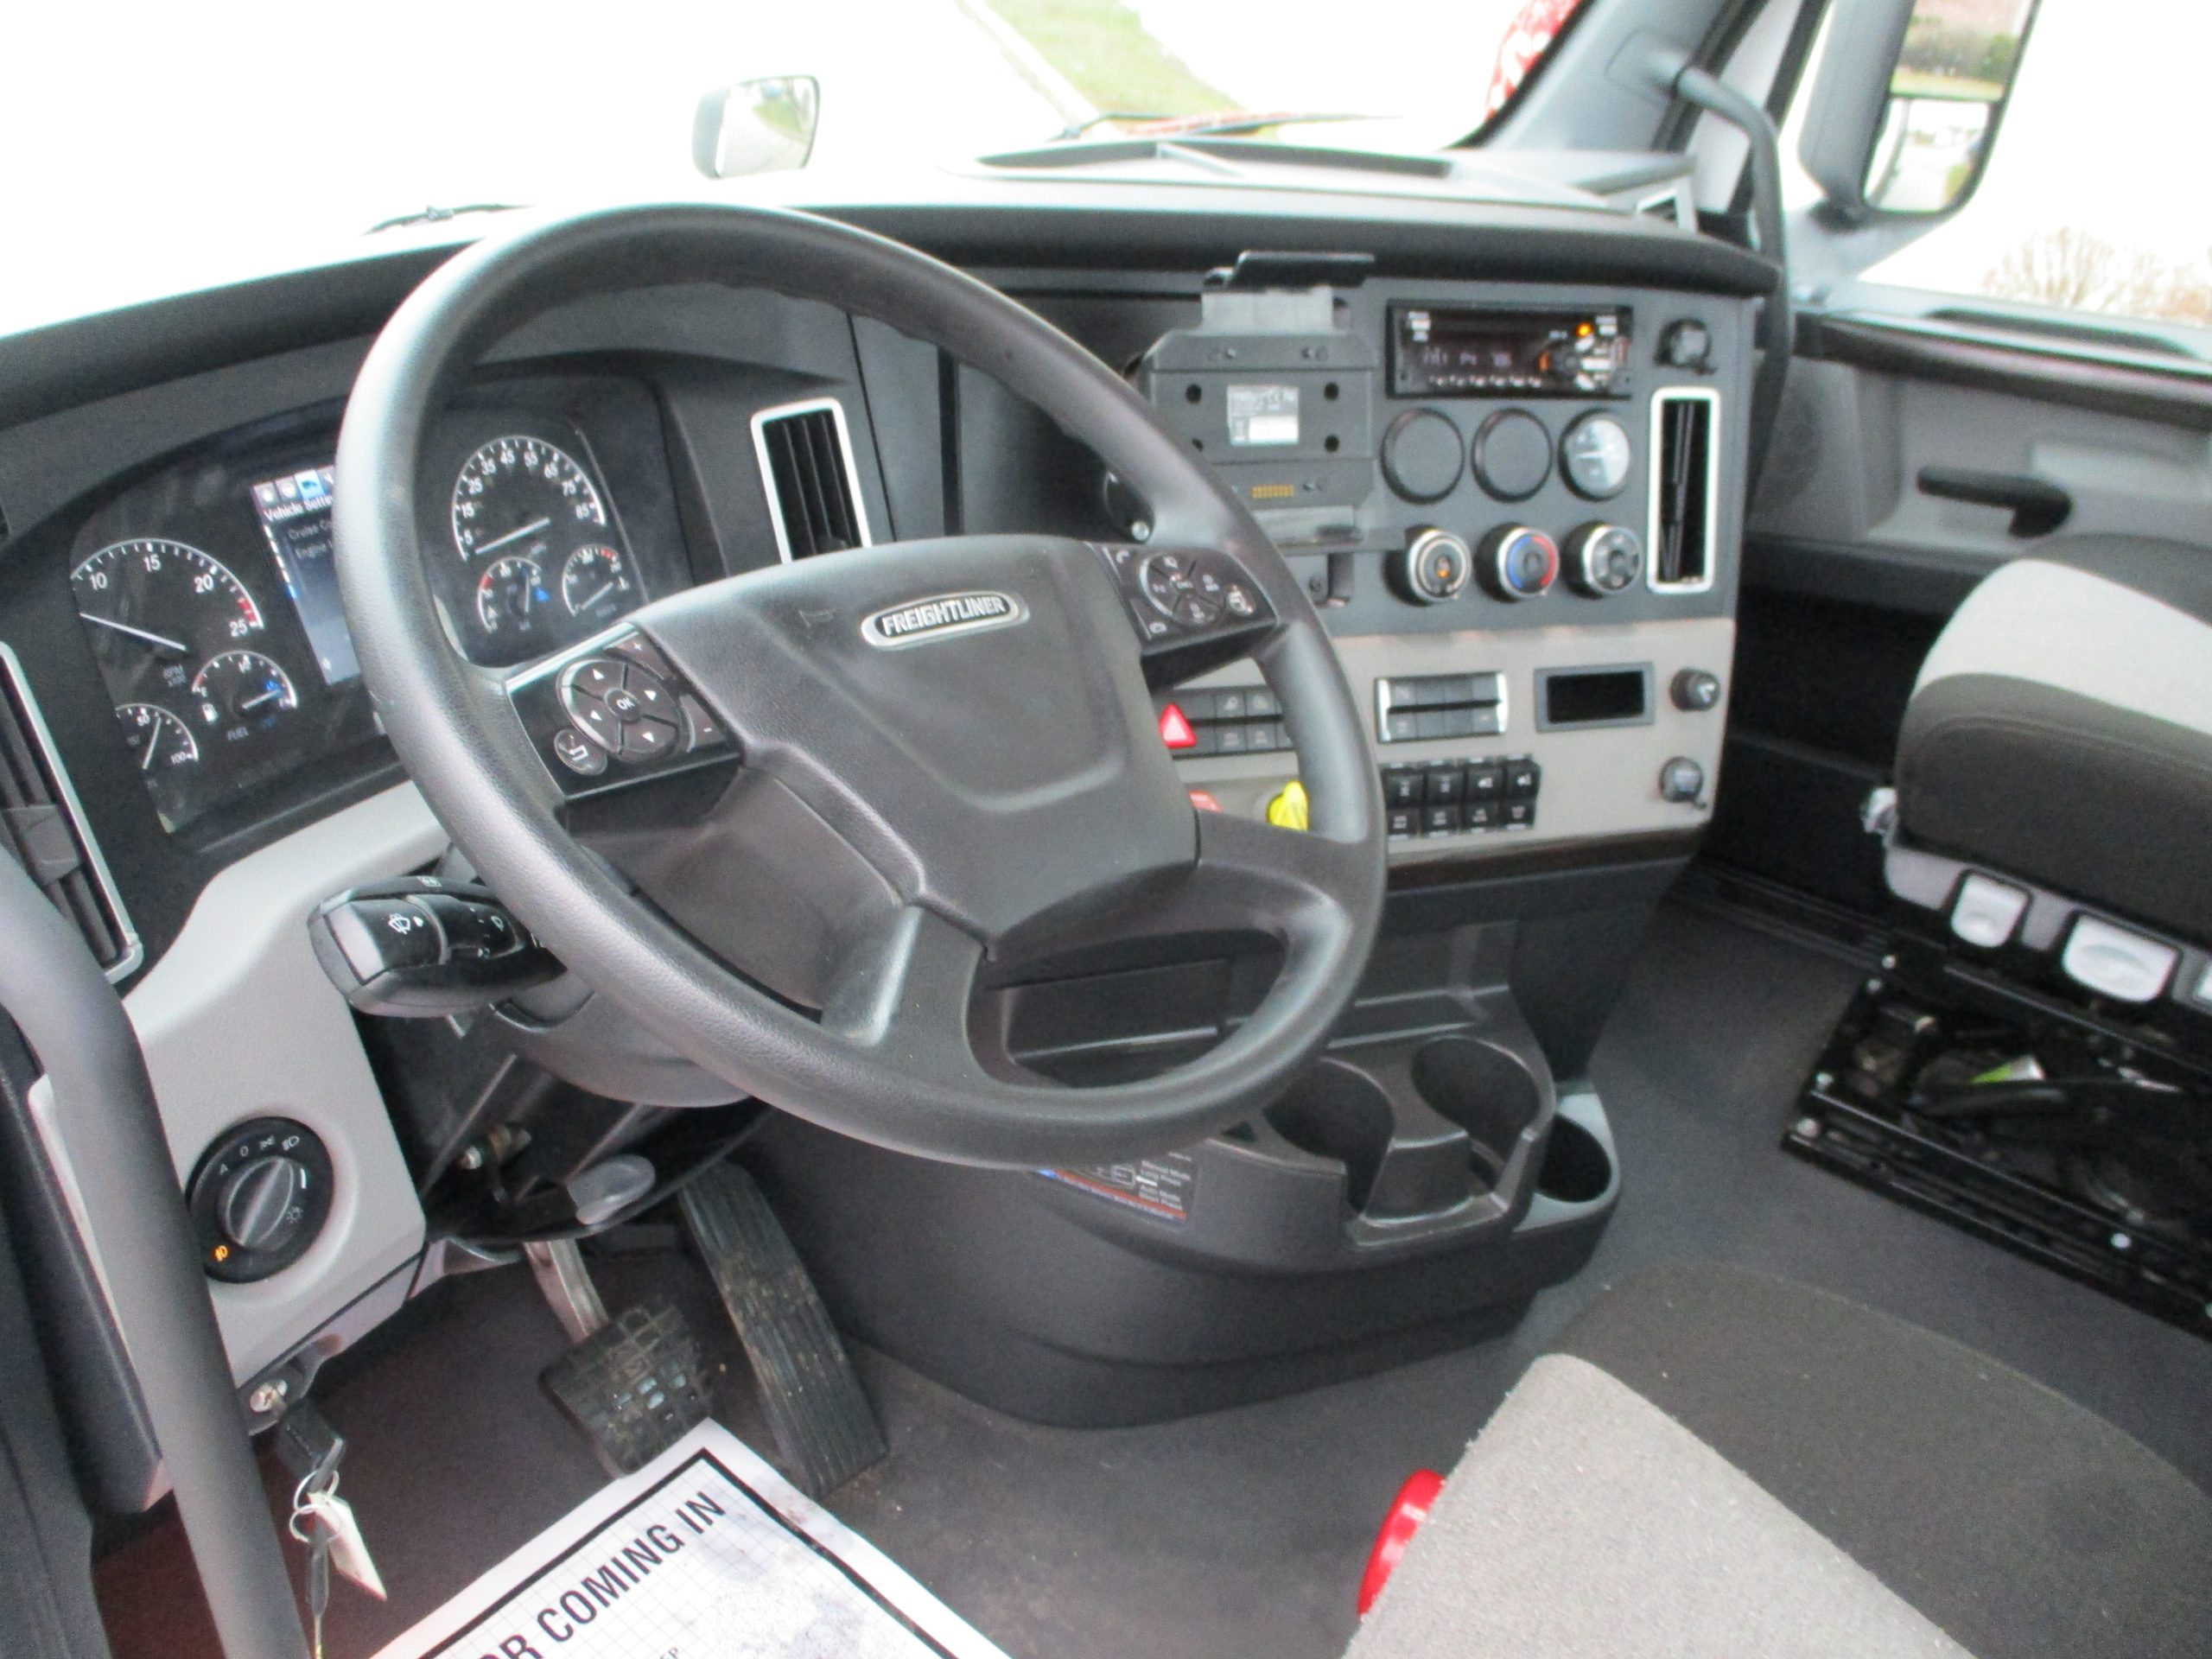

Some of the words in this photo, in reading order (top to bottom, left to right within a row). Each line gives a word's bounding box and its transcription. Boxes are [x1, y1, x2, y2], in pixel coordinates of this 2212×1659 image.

[562, 480, 577, 497] 75
[263, 502, 303, 522] Vehicle
[461, 501, 475, 518] 15
[143, 554, 162, 572] 15
[90, 572, 108, 591] 10
[194, 574, 214, 594] 20
[881, 595, 1007, 636] FREIGHTLINER
[229, 619, 248, 637] 25
[616, 696, 636, 710] OK
[227, 726, 250, 741] FUEL
[170, 750, 188, 765] 100
[537, 1524, 685, 1643] COMING
[676, 1491, 726, 1535] IN
